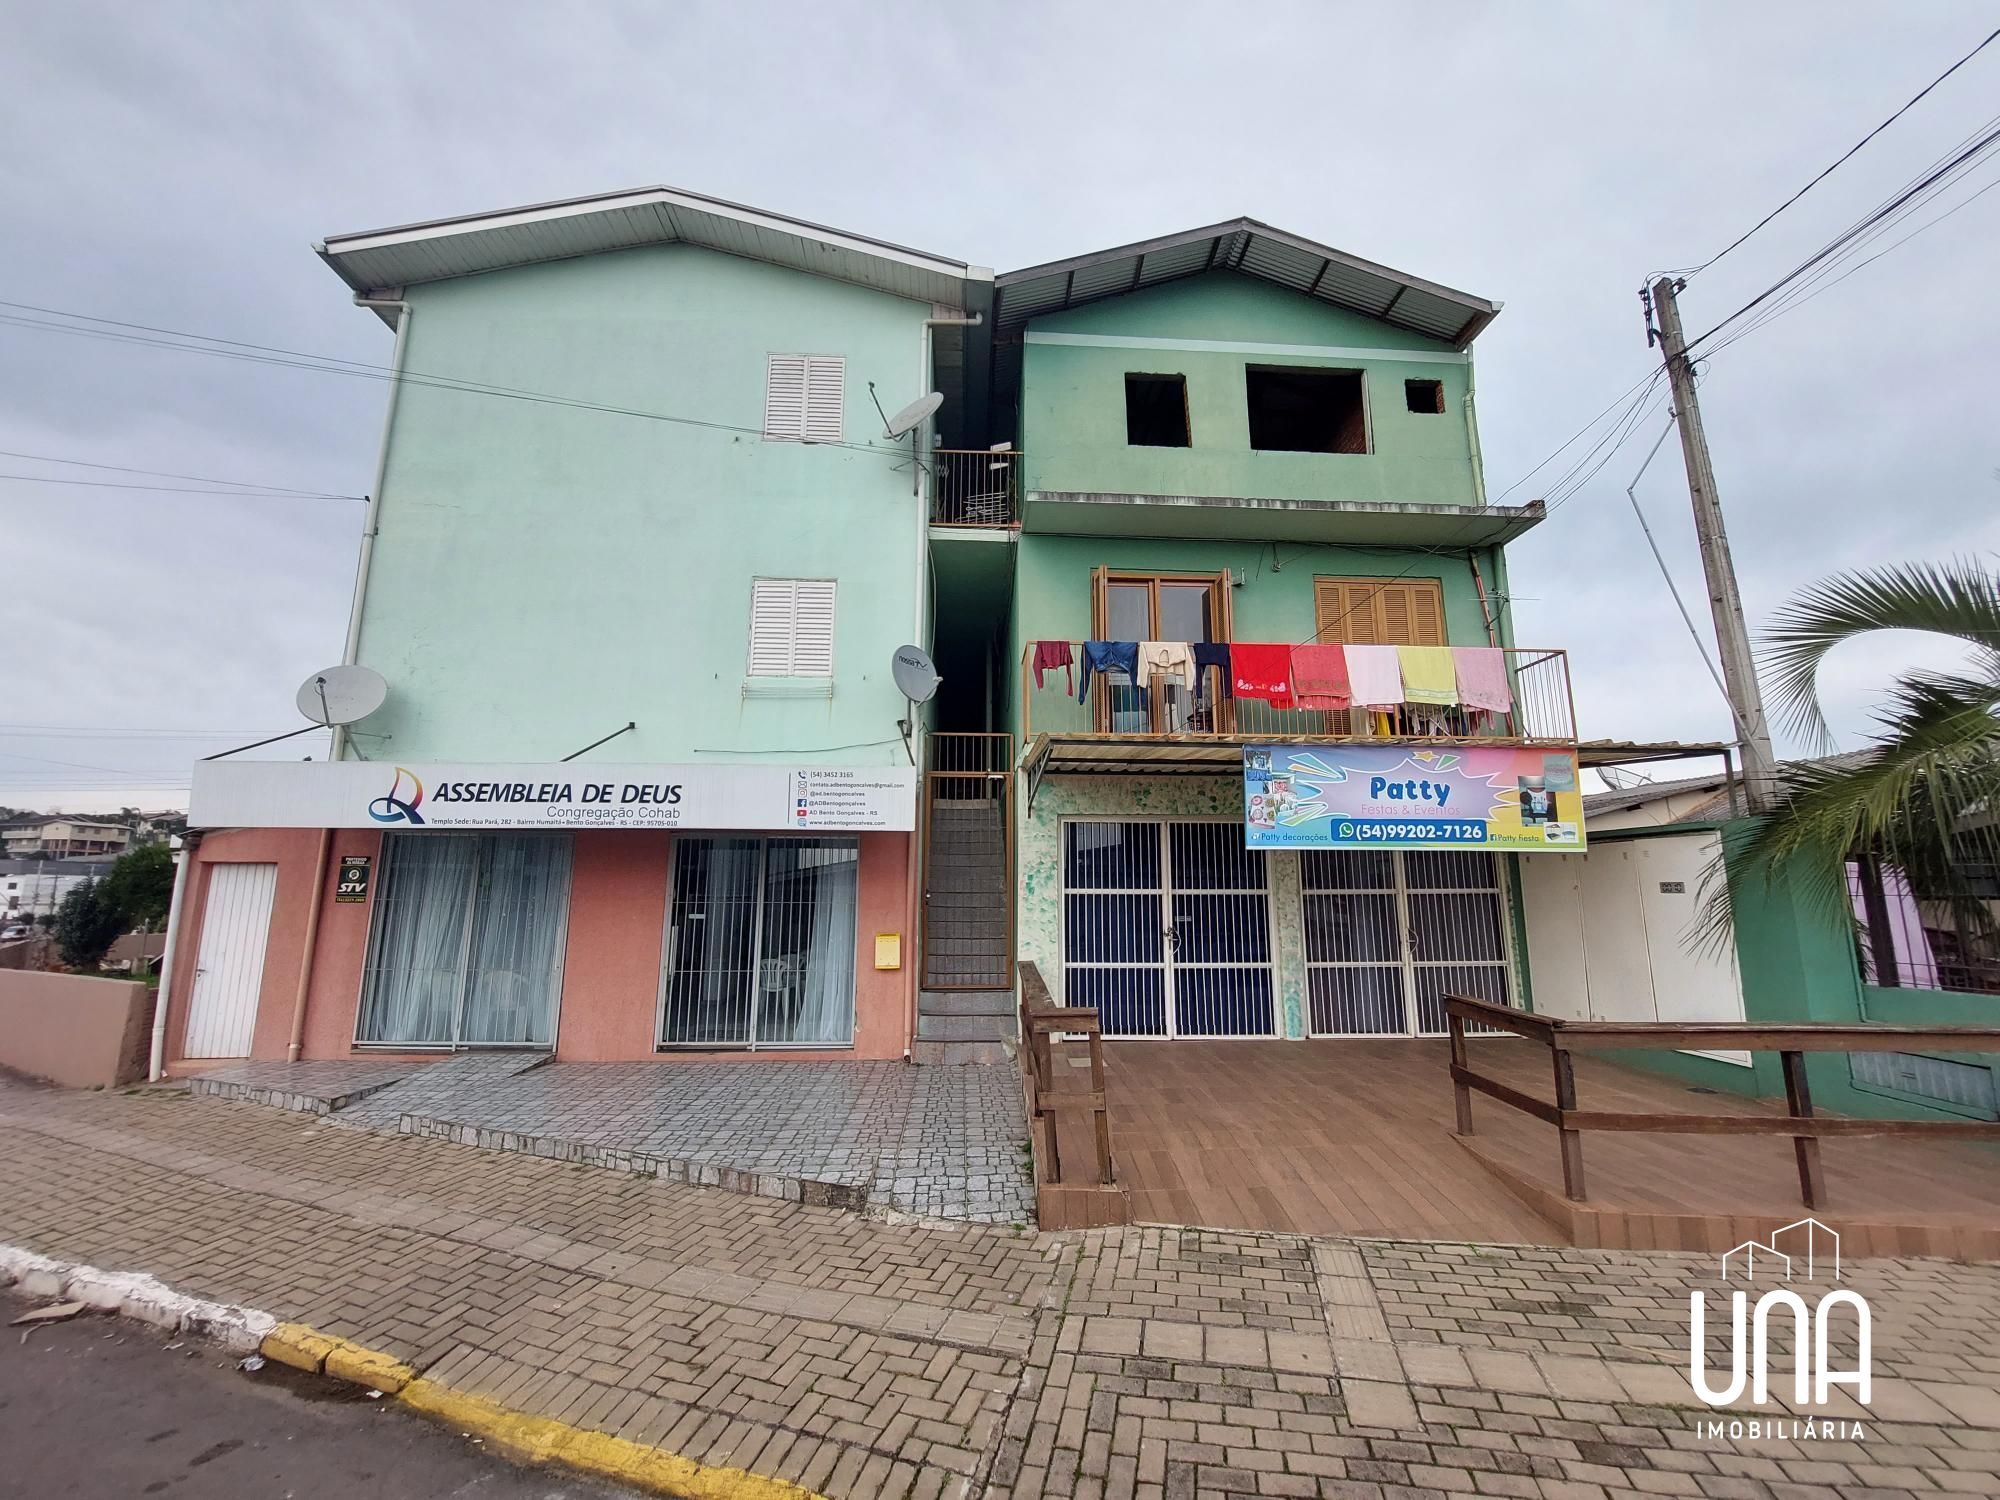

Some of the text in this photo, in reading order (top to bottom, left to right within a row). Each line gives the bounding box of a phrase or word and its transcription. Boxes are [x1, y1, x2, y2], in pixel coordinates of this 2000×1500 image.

[810, 771, 823, 779] (54)
[432, 783, 683, 804] ASSEMBLEIA DE DEUS
[1370, 776, 1451, 807] Patty
[547, 806, 681, 820] Congregação Cohab
[1361, 804, 1461, 815] Festas & Eventos
[485, 818, 499, 826] Pará,
[585, 819, 615, 827] Gonçalves
[809, 819, 886, 827] www.adbentogoncalves.com
[1261, 833, 1328, 842] Patty decorações
[1356, 824, 1482, 841] (54)99202-7126
[1497, 834, 1540, 843] Patty fiesta
[337, 882, 367, 892] STV
